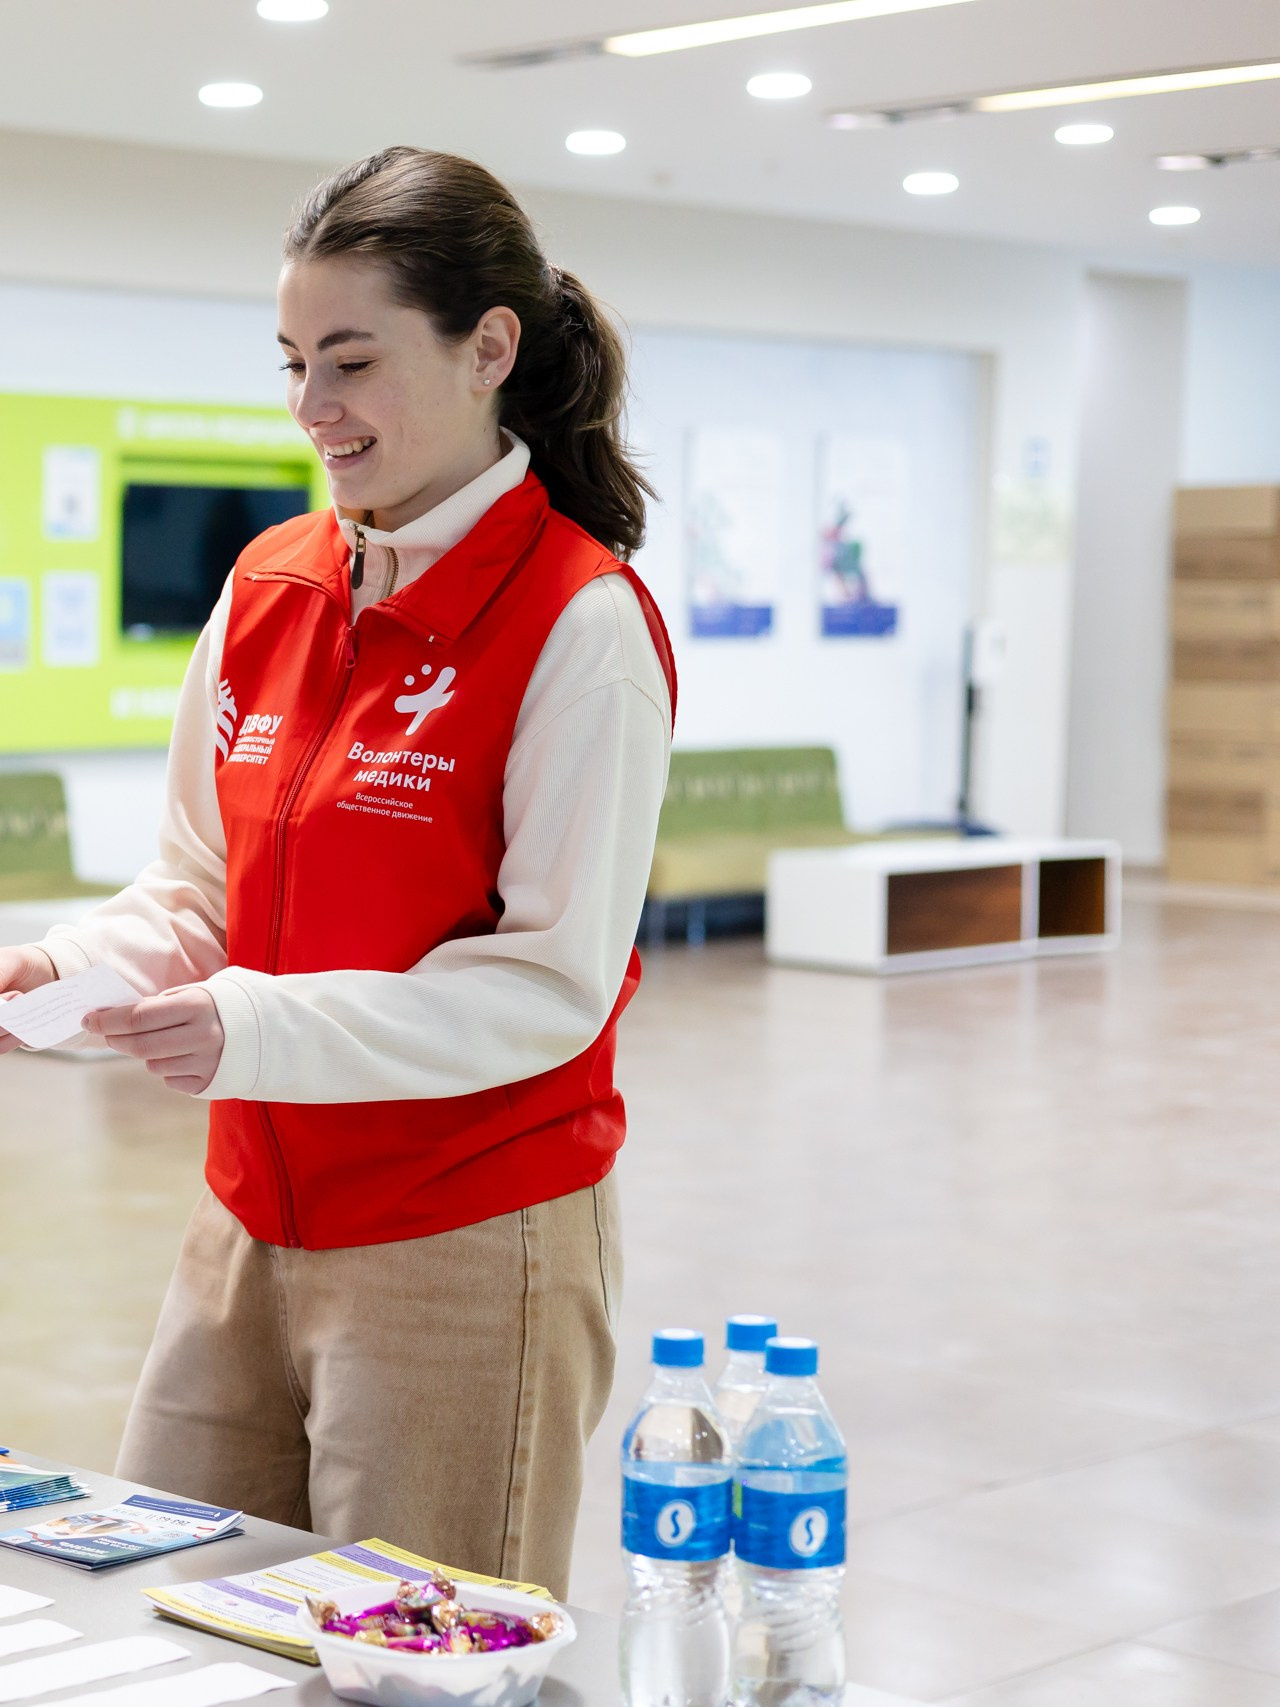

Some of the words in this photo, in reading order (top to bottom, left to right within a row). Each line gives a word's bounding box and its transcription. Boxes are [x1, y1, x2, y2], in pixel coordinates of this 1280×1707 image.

[238, 714, 283, 736] ДВФУ
[347, 741, 455, 774] Волонтеры
[352, 770, 431, 792] медики
[336, 801, 391, 817] общественное
[391, 810, 433, 823] движение
[355, 792, 414, 810] Всероссийское
